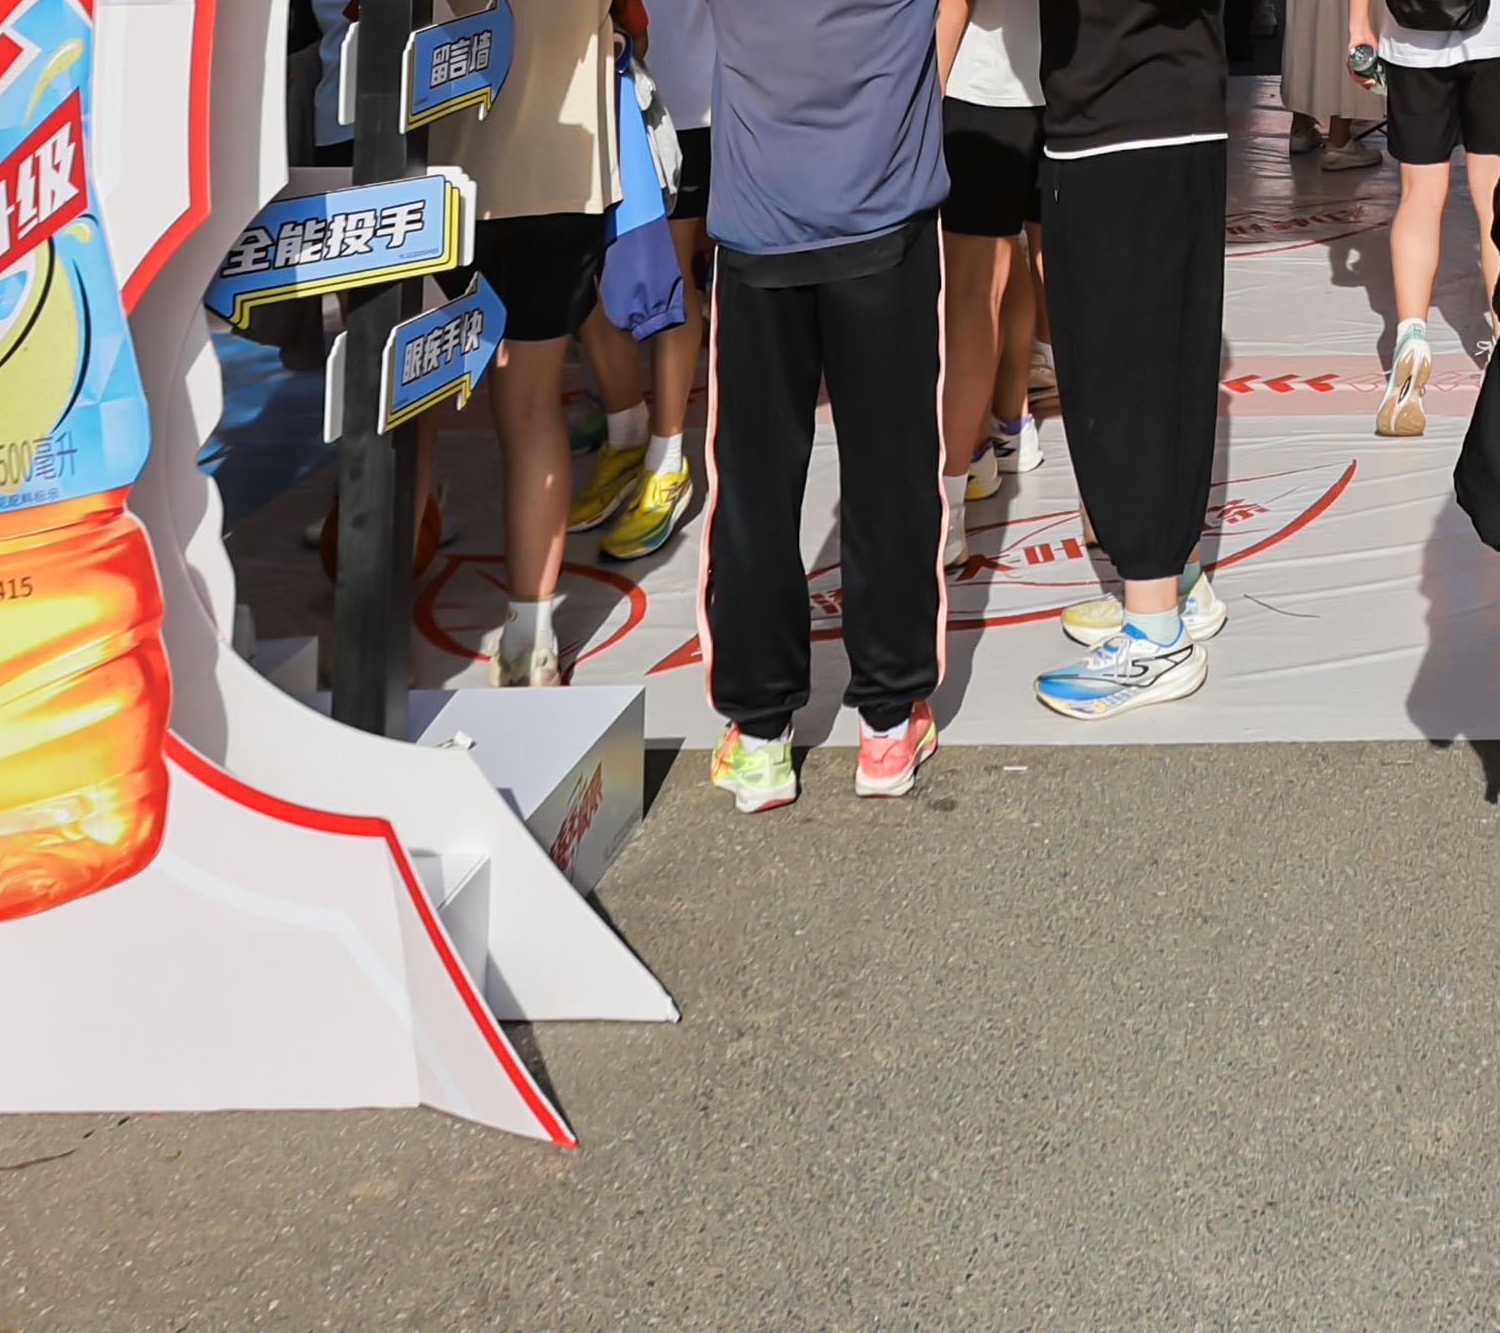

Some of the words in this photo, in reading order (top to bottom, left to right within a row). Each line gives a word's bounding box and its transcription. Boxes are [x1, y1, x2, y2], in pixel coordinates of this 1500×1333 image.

[429, 30, 492, 89] 留言墙
[221, 199, 426, 279] 全能投手
[401, 307, 484, 387] 眼疾手快
